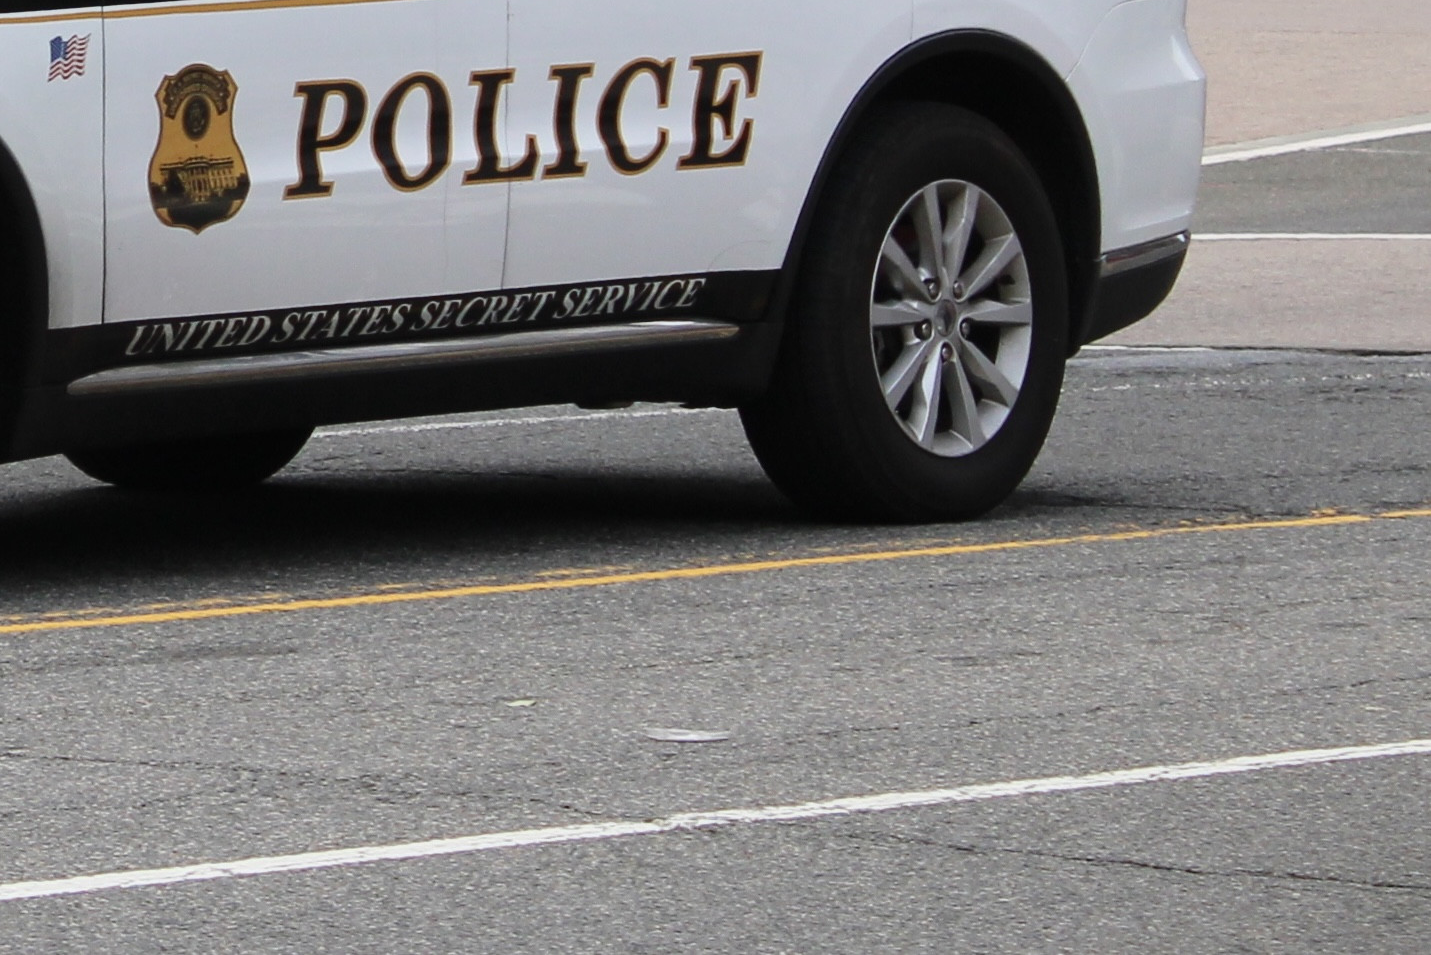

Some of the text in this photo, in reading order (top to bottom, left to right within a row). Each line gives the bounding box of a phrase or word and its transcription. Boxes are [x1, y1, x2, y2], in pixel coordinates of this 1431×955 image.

[282, 49, 764, 201] POLICE
[125, 277, 707, 356] UNITED STATES SECRET SERVICE
